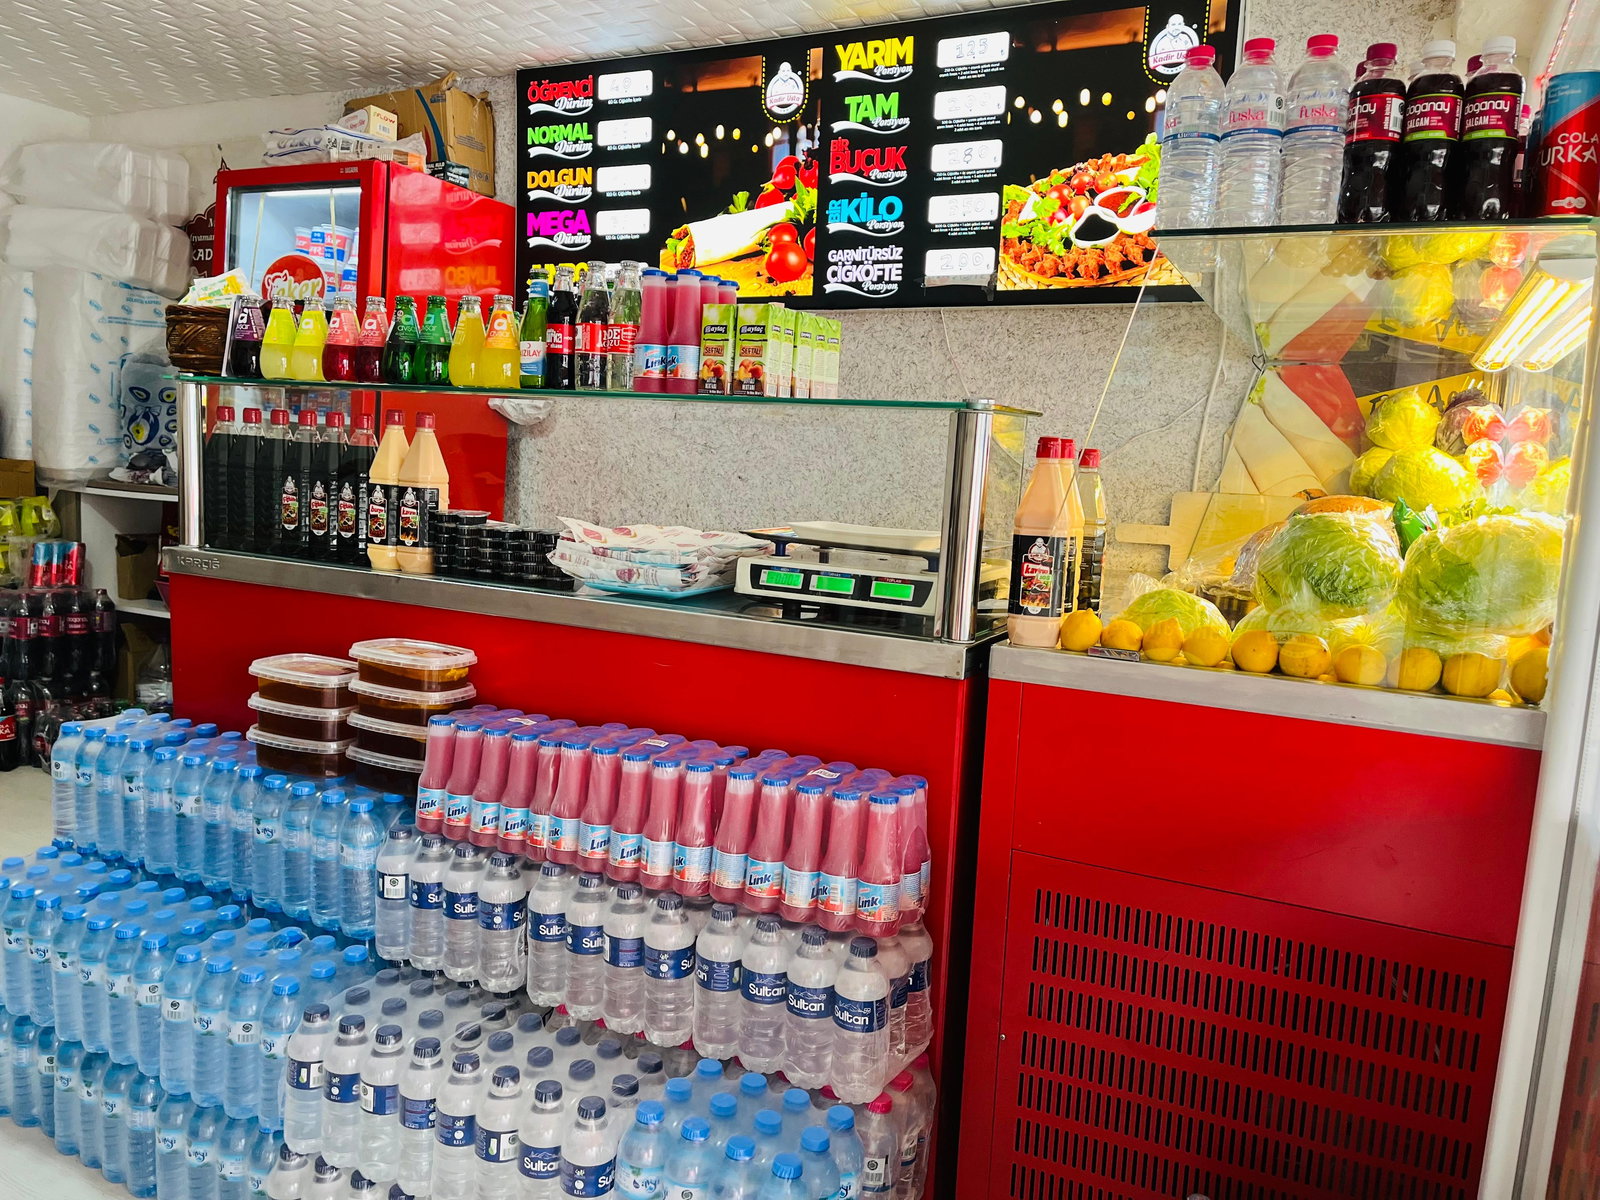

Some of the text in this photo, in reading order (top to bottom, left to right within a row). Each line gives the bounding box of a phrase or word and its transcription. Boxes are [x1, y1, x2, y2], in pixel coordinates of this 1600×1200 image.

[835, 36, 914, 70] YARIM
[874, 64, 913, 77] Porsiyon
[527, 75, 593, 102] ÖĞRENCİ
[554, 96, 593, 110] Dürüm
[845, 92, 899, 122] TAM
[872, 116, 910, 129] Porsiyon
[527, 122, 593, 145] NORMAL
[1558, 132, 1600, 145] COLA
[554, 140, 593, 154] Dürüm
[830, 137, 850, 152] BİR
[830, 146, 908, 177] BUÇUK
[1541, 144, 1598, 167] URKA
[527, 166, 593, 189] DOLGUN
[869, 168, 908, 181] Porsiyon
[553, 184, 592, 197] Dürüm
[826, 192, 903, 223] BİR KİLO
[527, 209, 591, 237] MEGA
[866, 219, 904, 232] Porsiyon
[553, 231, 592, 244] Dürüm
[828, 245, 904, 263] GARNİTÜRSÜZ
[826, 260, 904, 284] ÇİĞKÖFTE
[861, 280, 898, 293] Porsiyon
[645, 356, 667, 369] Link
[418, 798, 437, 810] Link
[447, 805, 468, 817] Link
[504, 818, 528, 832] Link
[748, 873, 772, 886] Link
[857, 896, 880, 909] Link
[748, 983, 786, 997] Sultan
[788, 994, 825, 1012] Sultan
[834, 1005, 869, 1026] Sultan
